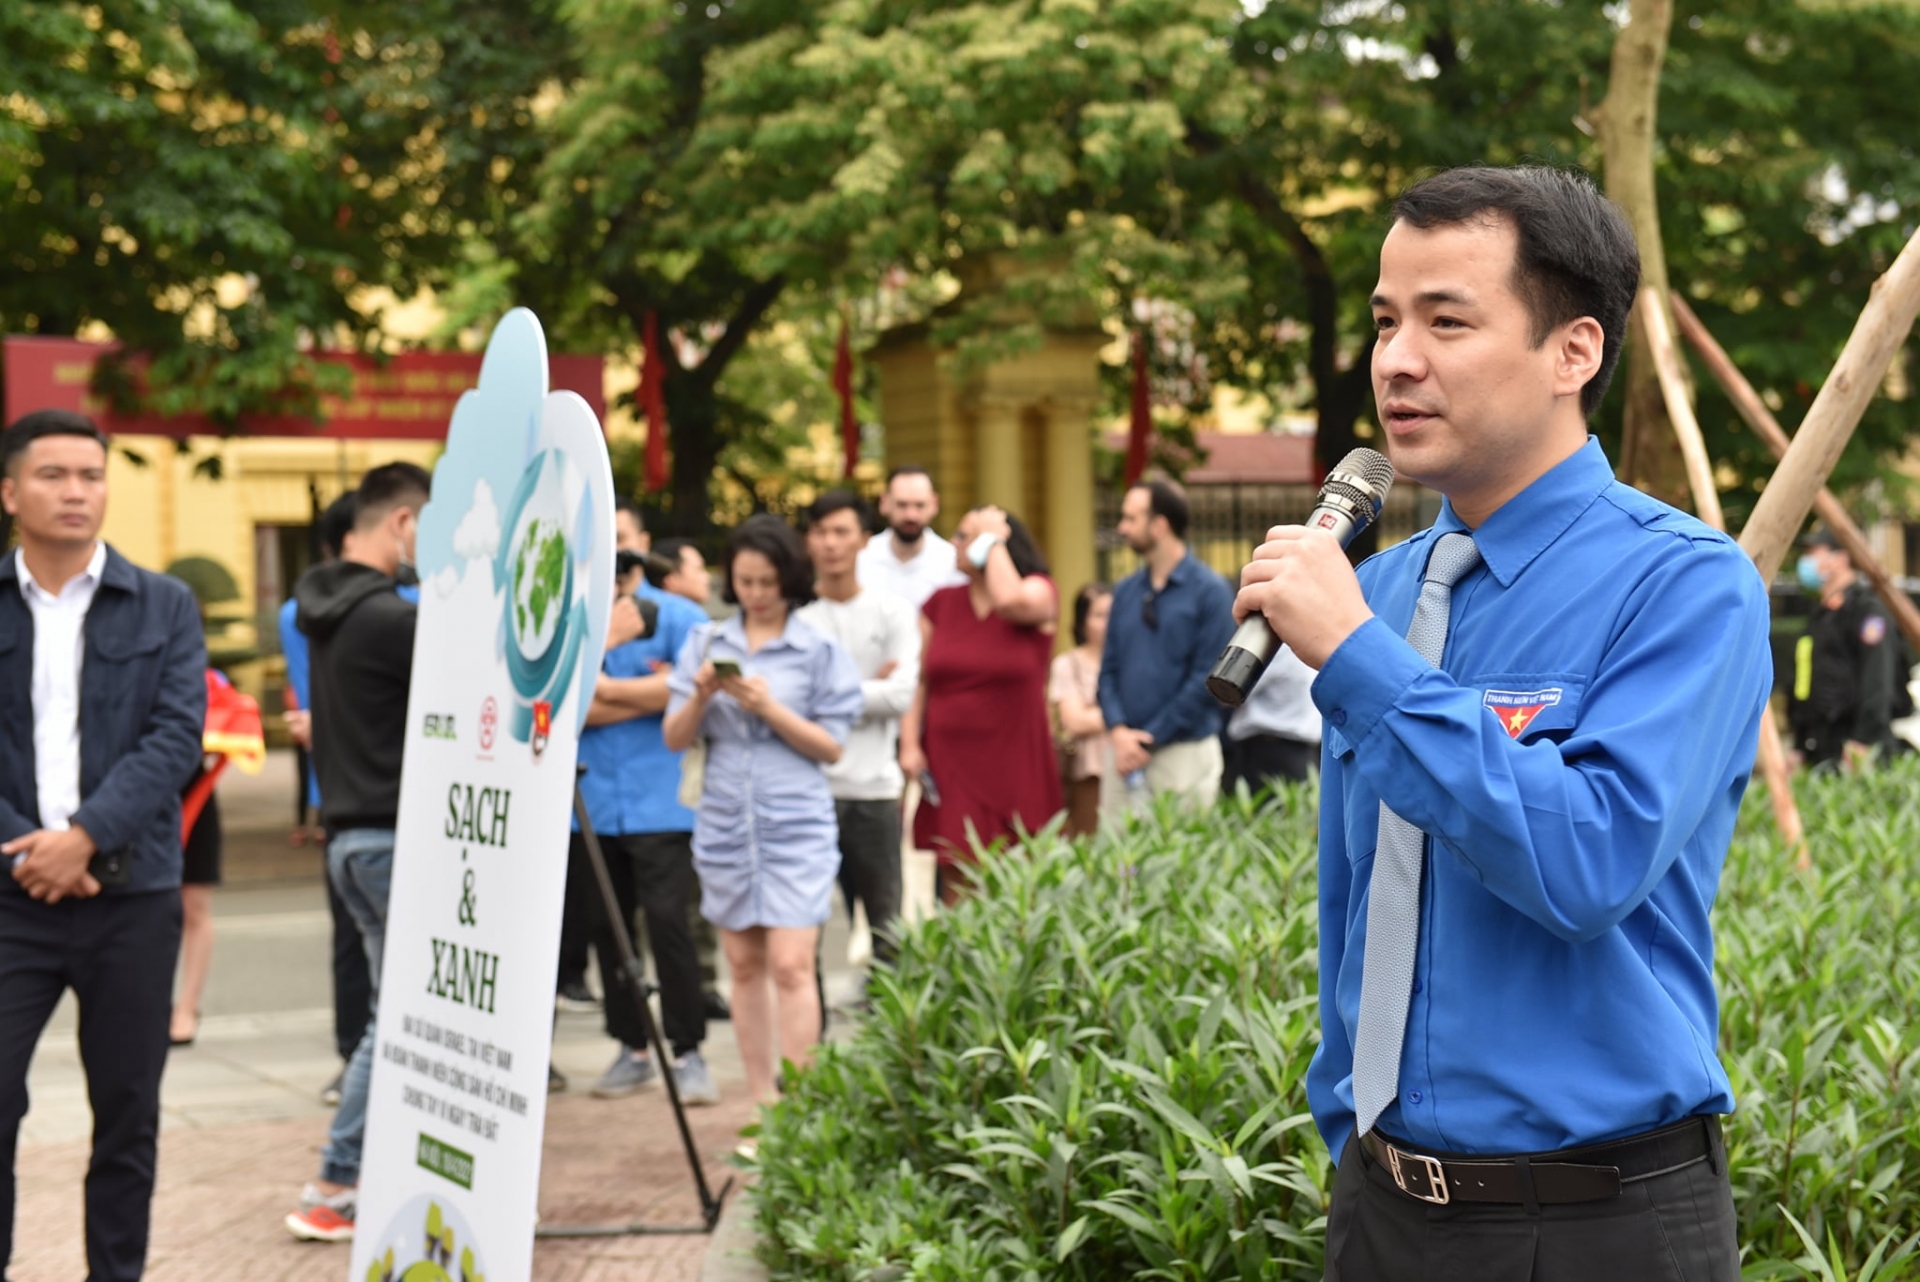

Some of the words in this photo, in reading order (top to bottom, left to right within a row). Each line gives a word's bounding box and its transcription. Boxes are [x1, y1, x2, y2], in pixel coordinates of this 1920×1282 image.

[1487, 694, 1512, 705] THANH
[1540, 693, 1558, 702] NAM
[445, 783, 511, 860] SẠCH
[458, 868, 477, 927] &
[426, 937, 499, 1014] XANH
